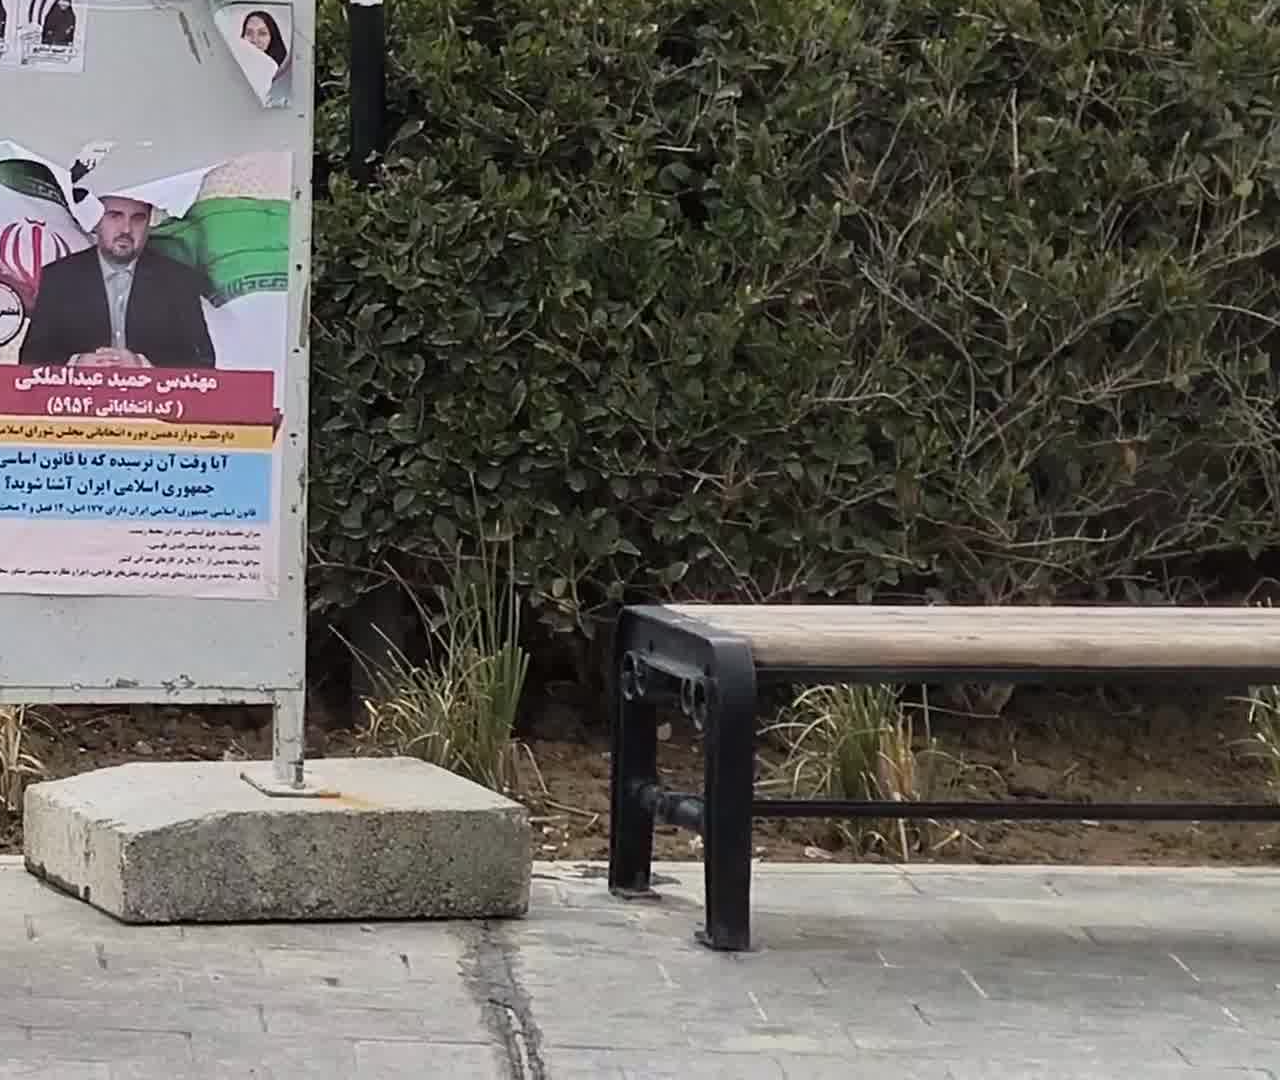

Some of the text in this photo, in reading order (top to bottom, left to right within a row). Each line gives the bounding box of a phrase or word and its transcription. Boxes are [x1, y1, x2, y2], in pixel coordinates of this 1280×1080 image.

[14, 366, 218, 393] مهندس حمید عبدالملکی
[96, 397, 153, 417] انتخاباتی
